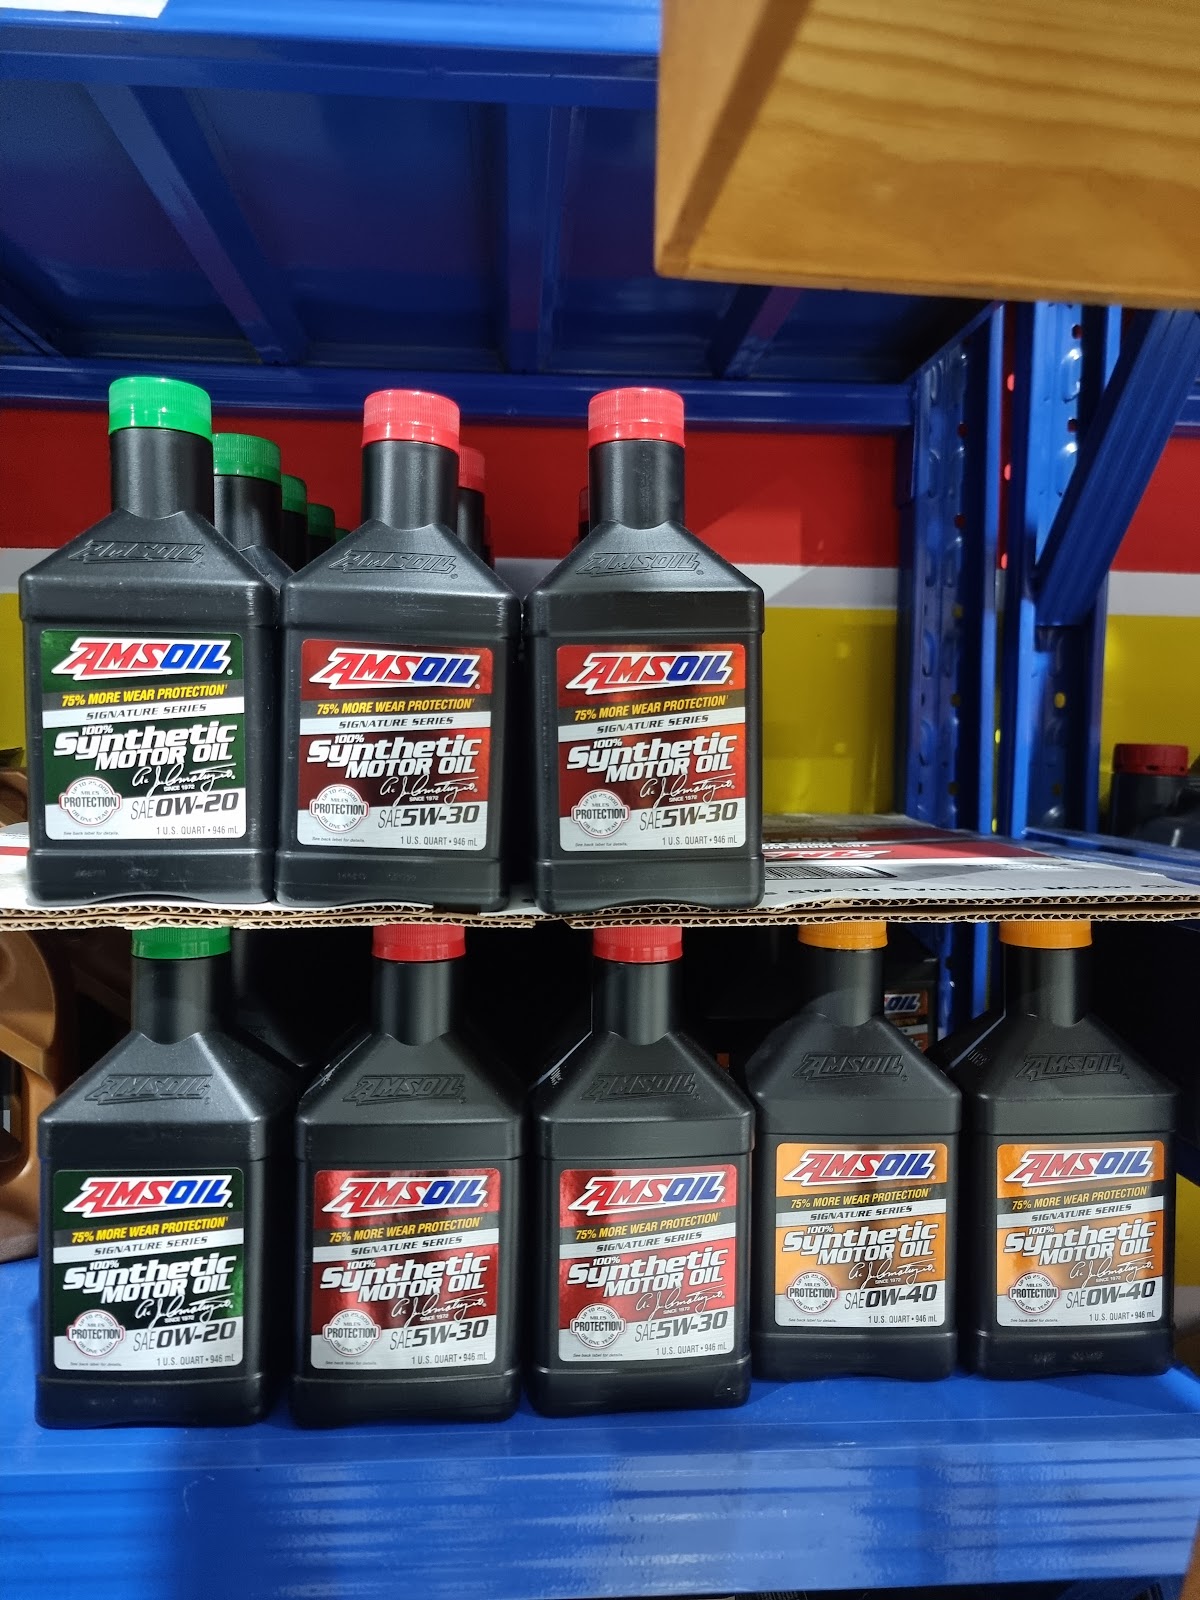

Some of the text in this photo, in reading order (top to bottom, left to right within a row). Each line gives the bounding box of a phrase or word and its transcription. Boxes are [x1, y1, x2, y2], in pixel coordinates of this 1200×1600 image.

[328, 550, 456, 574] AMSOIL
[576, 551, 700, 576] AMSOIL
[57, 639, 229, 679] AMSOIL
[314, 649, 478, 688] AMSOIL
[571, 653, 730, 693] AMSOIL
[62, 695, 85, 706] 75%
[88, 692, 120, 705] MORE
[123, 689, 154, 702] WEAR
[317, 704, 340, 714] 75%
[342, 703, 373, 714] MORE
[376, 701, 405, 712] WEAR
[86, 704, 206, 720] SIGNATURE SERIES
[575, 709, 597, 721] 75%
[599, 705, 629, 718] MORE
[632, 702, 660, 715] WEAR
[82, 725, 113, 735] 100%
[339, 717, 454, 729] SIGNATURE SERIES
[597, 715, 709, 734] SIGNATURE SERIES
[53, 721, 237, 760] Synthetic
[334, 734, 365, 743] 100%
[593, 738, 622, 749] 100%
[95, 743, 231, 770] MOTOR OIL
[307, 734, 482, 767] Synthetic
[567, 731, 737, 773] Synthetic
[345, 756, 475, 778] MOTOR OIL
[605, 753, 732, 783] MOTOR OIL
[63, 796, 117, 807] PROTECTION
[131, 792, 238, 820] SAE 0W-20
[313, 803, 364, 815] PROTECTION
[378, 805, 480, 828] SAE 5W-30
[576, 808, 625, 819] PROTECTION
[640, 802, 738, 831] SAE 5W-30
[163, 826, 179, 835] U.S.
[181, 826, 206, 835] QUART
[212, 826, 225, 835] 946
[668, 836, 682, 845] U.S.
[685, 836, 707, 844] QUART
[714, 835, 726, 844] 946
[406, 836, 421, 845] U.S.
[424, 837, 447, 845] QUART
[453, 838, 466, 846] 946
[792, 1053, 903, 1080] AMSOIL
[788, 1151, 934, 1185] AMSOIL
[1009, 1149, 1152, 1186] AMSOIL
[69, 1176, 231, 1216] AMSOIL
[327, 1178, 486, 1217] AMSOIL
[573, 1175, 724, 1215] AMSOIL
[791, 1199, 811, 1209] 75%
[813, 1197, 840, 1208] MORE
[843, 1193, 869, 1205] WEAR
[1012, 1200, 1032, 1211] 75%
[1034, 1197, 1061, 1208] MORE
[1063, 1193, 1089, 1205] WEAR
[811, 1206, 913, 1222] SIGNATURE SERIES
[1032, 1204, 1132, 1222] SIGNATURE SERIES
[72, 1232, 94, 1243] 75%
[97, 1228, 127, 1241] MORE
[130, 1224, 158, 1237] WEAR
[330, 1232, 352, 1243] 75%
[354, 1228, 384, 1241] MORE
[387, 1224, 415, 1237] WEAR
[576, 1229, 597, 1240] 75%
[599, 1225, 627, 1238] MORE
[630, 1221, 657, 1234] WEAR
[783, 1221, 939, 1256] Synthetic
[807, 1225, 834, 1235] 100%
[1004, 1219, 1157, 1257] Synthetic
[1028, 1225, 1054, 1235] 100%
[94, 1236, 208, 1256] SIGNATURE SERIES
[351, 1236, 463, 1256] SIGNATURE SERIES
[597, 1232, 703, 1252] SIGNATURE SERIES
[1039, 1238, 1152, 1265] MOTOR OIL
[593, 1255, 620, 1266] 100%
[817, 1241, 933, 1265] MOTOR OIL
[63, 1253, 236, 1294] Synthetic
[90, 1259, 119, 1270] 100%
[320, 1252, 490, 1293] Synthetic
[347, 1259, 376, 1270] 100%
[567, 1247, 729, 1288] Synthetic
[101, 1274, 230, 1303] MOTOR OIL
[357, 1273, 484, 1303] MOTOR OIL
[603, 1267, 723, 1297] MOTOR OIL
[790, 1288, 835, 1297] PROTECTION
[845, 1284, 938, 1309] SAE 0W-40
[1012, 1288, 1056, 1298] PROTECTION
[1066, 1281, 1155, 1308] SAE 0W-40
[575, 1320, 622, 1332] PROTECTION
[889, 1314, 910, 1322] QUART
[915, 1314, 926, 1322] 946
[1094, 1312, 1107, 1321] U.S.
[1109, 1312, 1129, 1320] QUART
[1135, 1311, 1146, 1319] 946
[71, 1328, 121, 1339] PROTECTION
[135, 1322, 236, 1351] SAE 0W-20
[327, 1327, 376, 1338] PROTECTION
[390, 1321, 489, 1349] SAE 5W-30
[635, 1312, 728, 1341] SAE 5W-30
[661, 1345, 675, 1354] U.S.
[677, 1344, 699, 1353] QUART
[704, 1343, 716, 1351] 946
